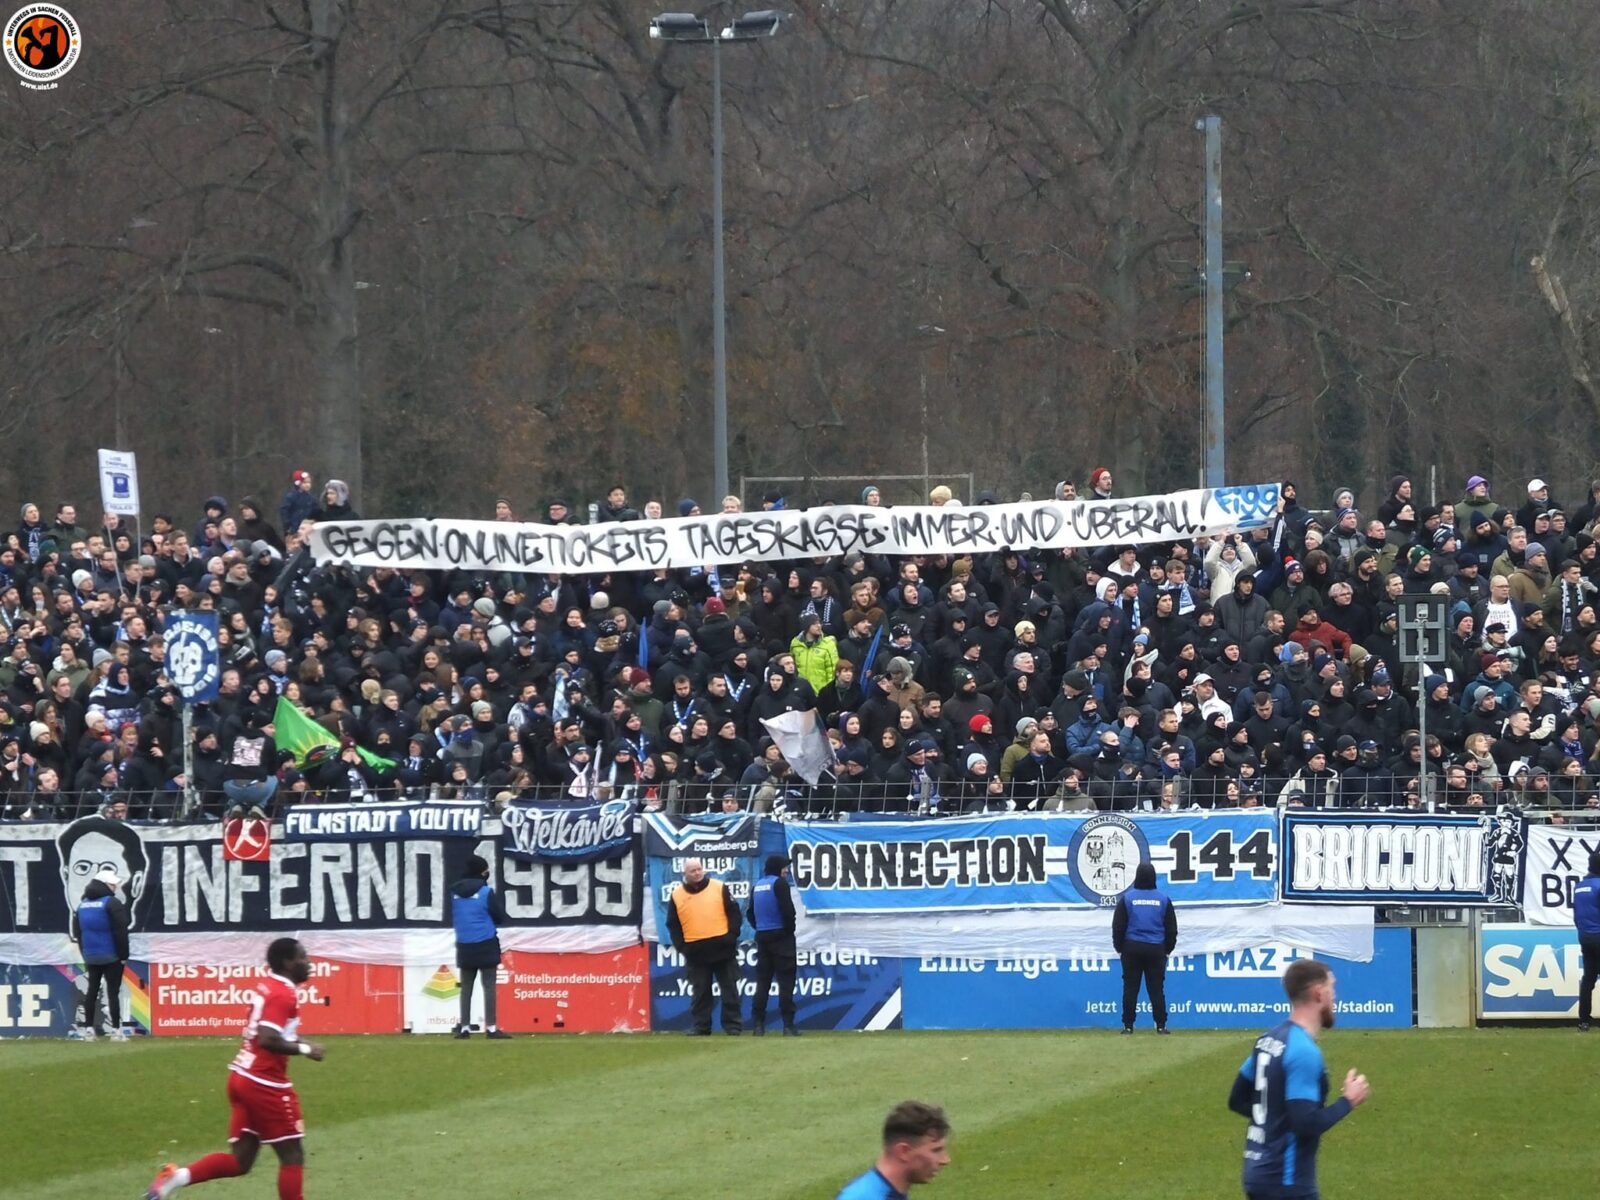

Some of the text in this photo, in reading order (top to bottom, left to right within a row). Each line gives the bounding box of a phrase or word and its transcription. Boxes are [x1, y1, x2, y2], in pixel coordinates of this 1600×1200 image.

[1001, 507, 1063, 544] UND
[286, 808, 480, 834] FILMSTADT YOUTH
[1082, 815, 1136, 832] CONNECTION
[789, 829, 1274, 890] CONNECTION 144
[1292, 825, 1484, 892] BRICCONI
[162, 840, 443, 925] INFERNO
[474, 841, 633, 918] 1999
[796, 942, 878, 967] erden.
[158, 963, 199, 978] Das
[514, 973, 643, 986] Mittelbrandenburgische
[514, 988, 569, 1000] Sparkasse
[1085, 1001, 1117, 1013] Jetzt
[1169, 1000, 1192, 1013] auf
[158, 1017, 186, 1027] Lohnt
[188, 1017, 207, 1027] sich
